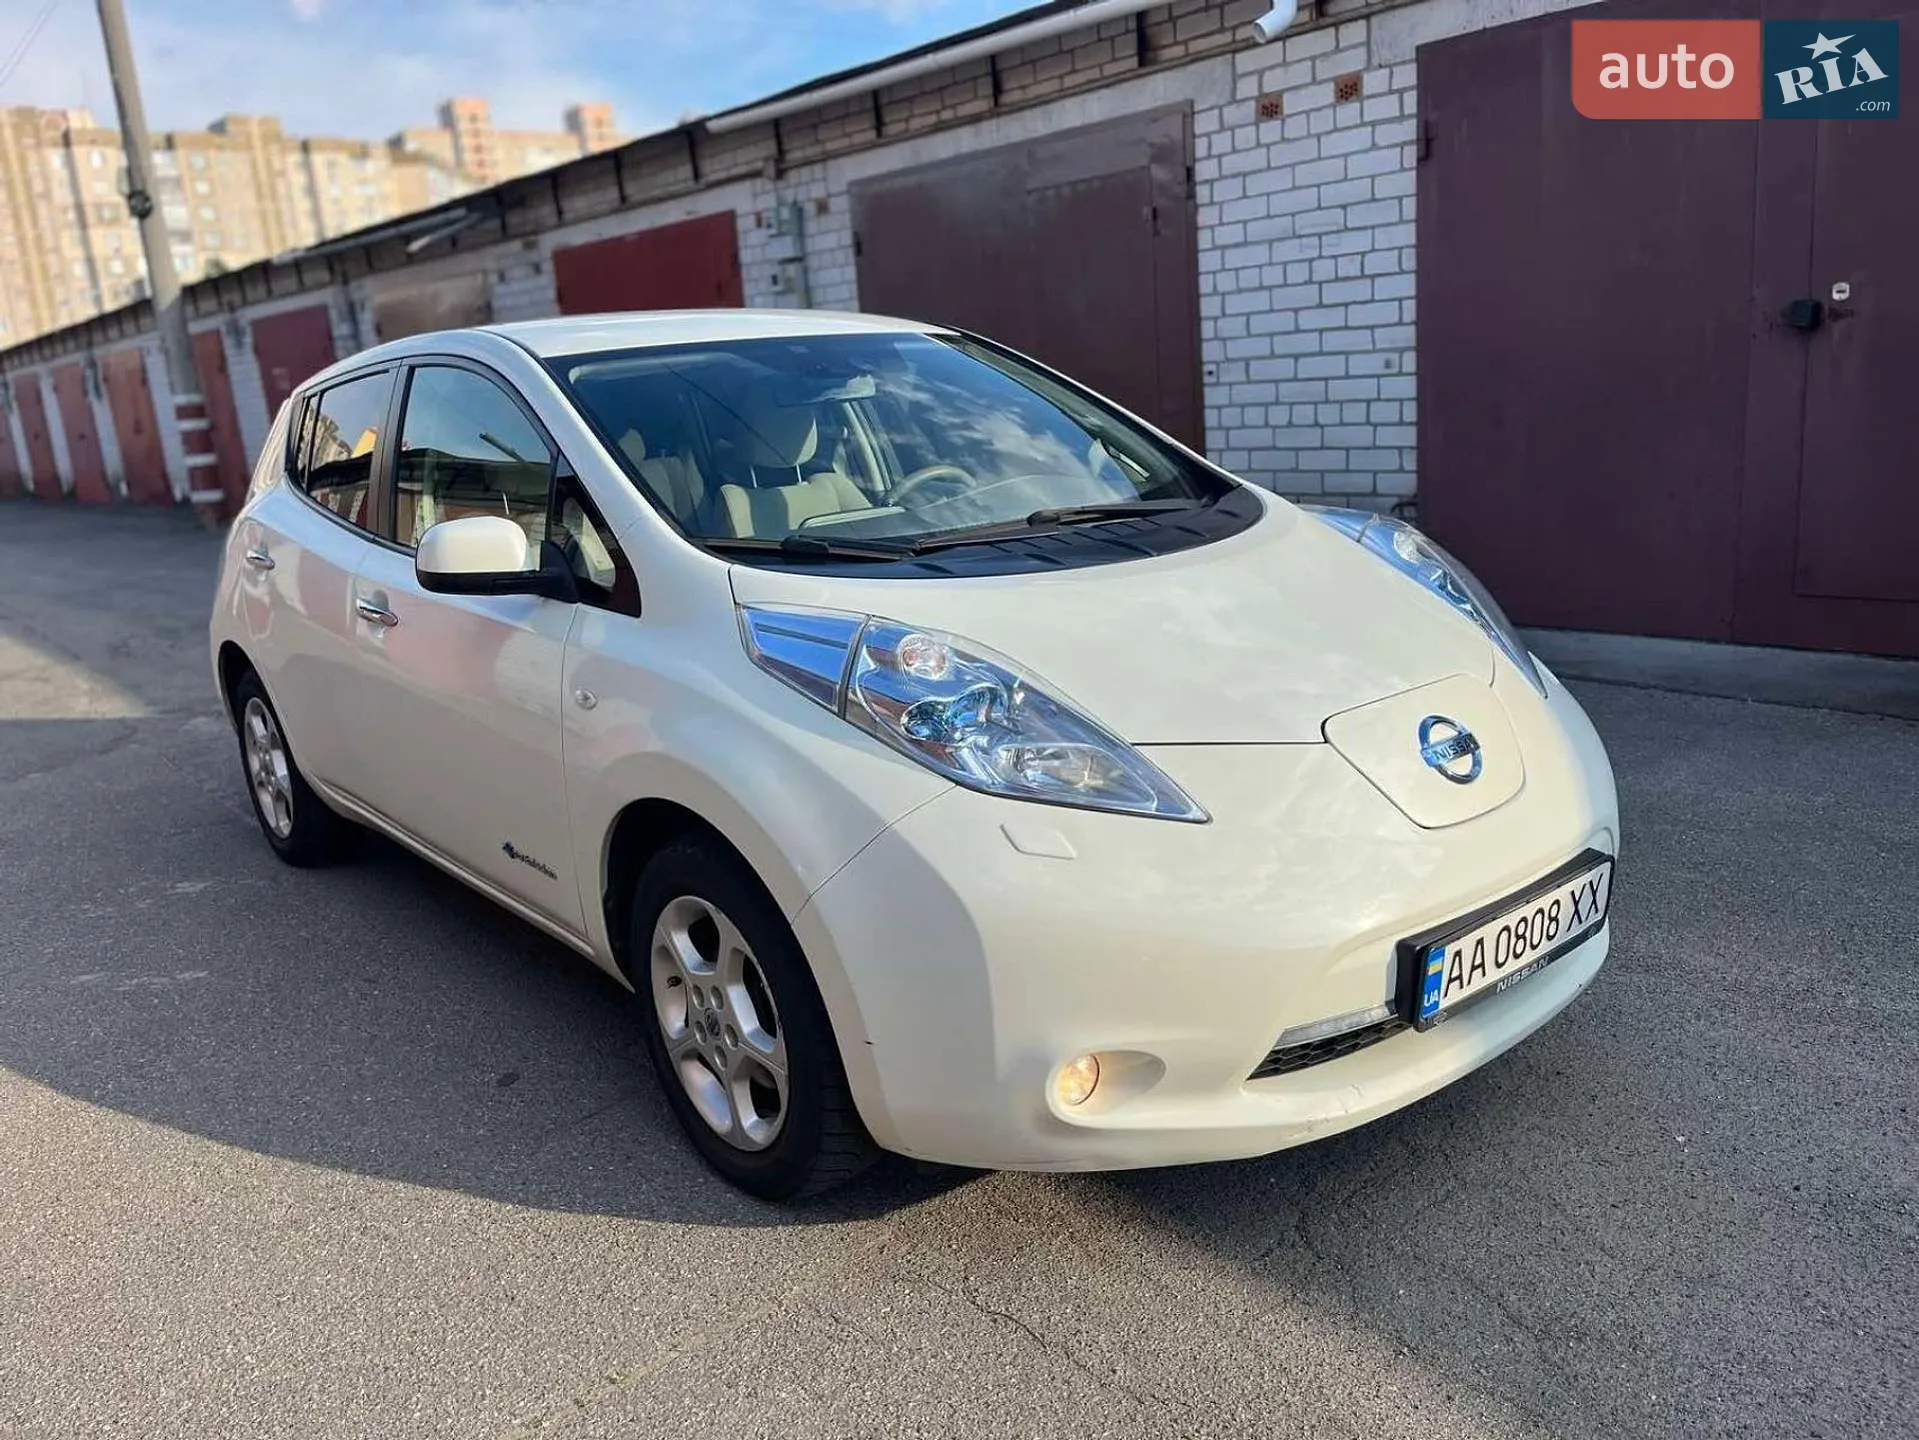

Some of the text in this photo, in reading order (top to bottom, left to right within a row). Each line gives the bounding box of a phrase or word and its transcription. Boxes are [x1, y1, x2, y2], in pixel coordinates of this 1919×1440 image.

[1443, 873, 1604, 999] AA 0808 XX
[1495, 956, 1550, 994] NISSAN
[1423, 989, 1440, 1008] UA
